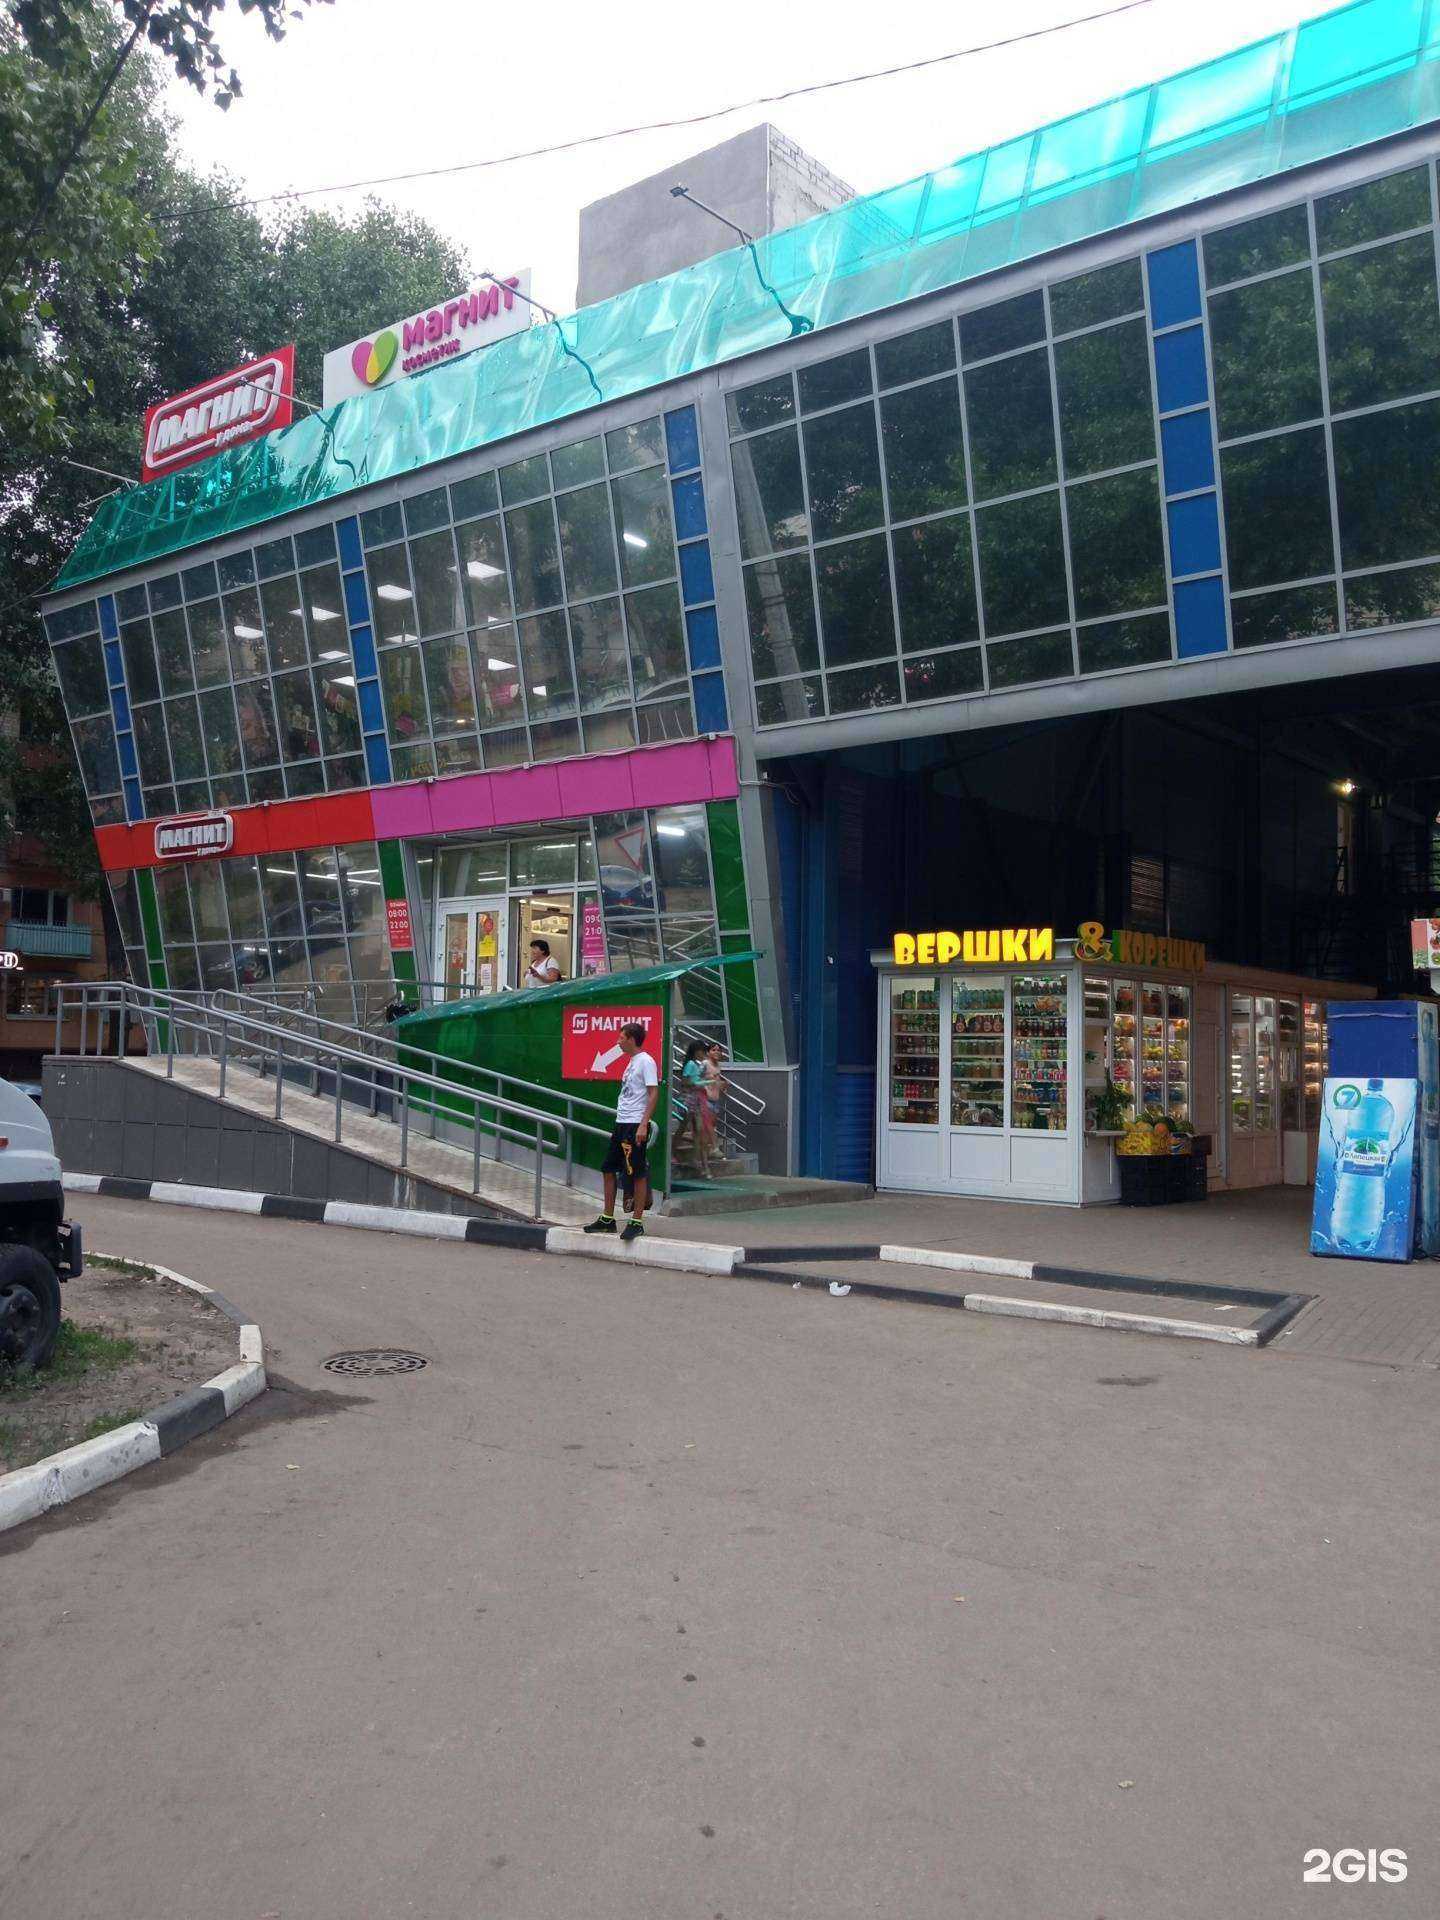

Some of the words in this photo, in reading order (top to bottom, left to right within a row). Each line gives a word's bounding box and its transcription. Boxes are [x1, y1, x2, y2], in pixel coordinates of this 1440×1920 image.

[153, 373, 275, 454] МАГНИТ
[160, 822, 227, 850] МАГНИТ
[893, 928, 1054, 966] ВЕРШКИ
